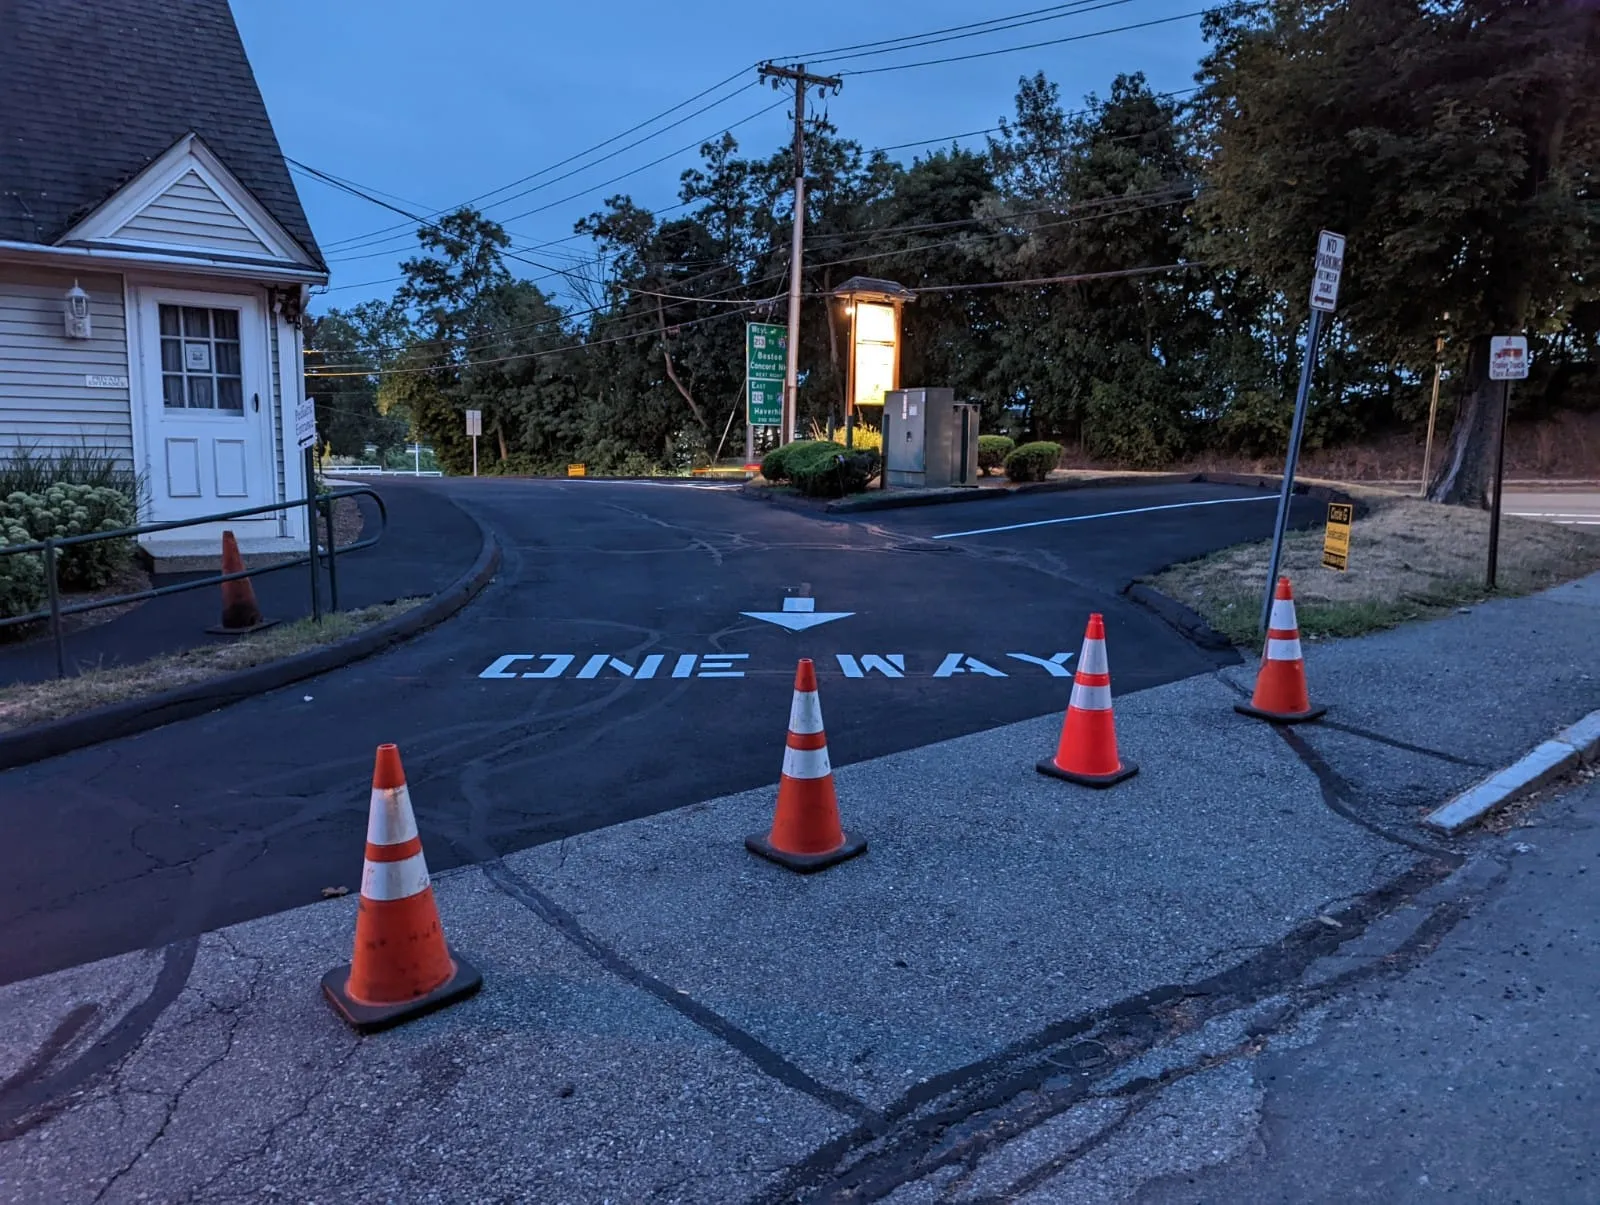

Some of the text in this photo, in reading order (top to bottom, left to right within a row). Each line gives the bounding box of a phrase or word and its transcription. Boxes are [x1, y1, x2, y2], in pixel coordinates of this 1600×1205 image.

[1326, 239, 1337, 253] NO
[1319, 253, 1342, 270] PARKING
[1318, 270, 1337, 283] BETWEEN
[757, 351, 783, 361] Boston
[750, 361, 776, 371] Concord
[754, 407, 781, 416] Haverhi
[479, 652, 1075, 679] ONE WAY
